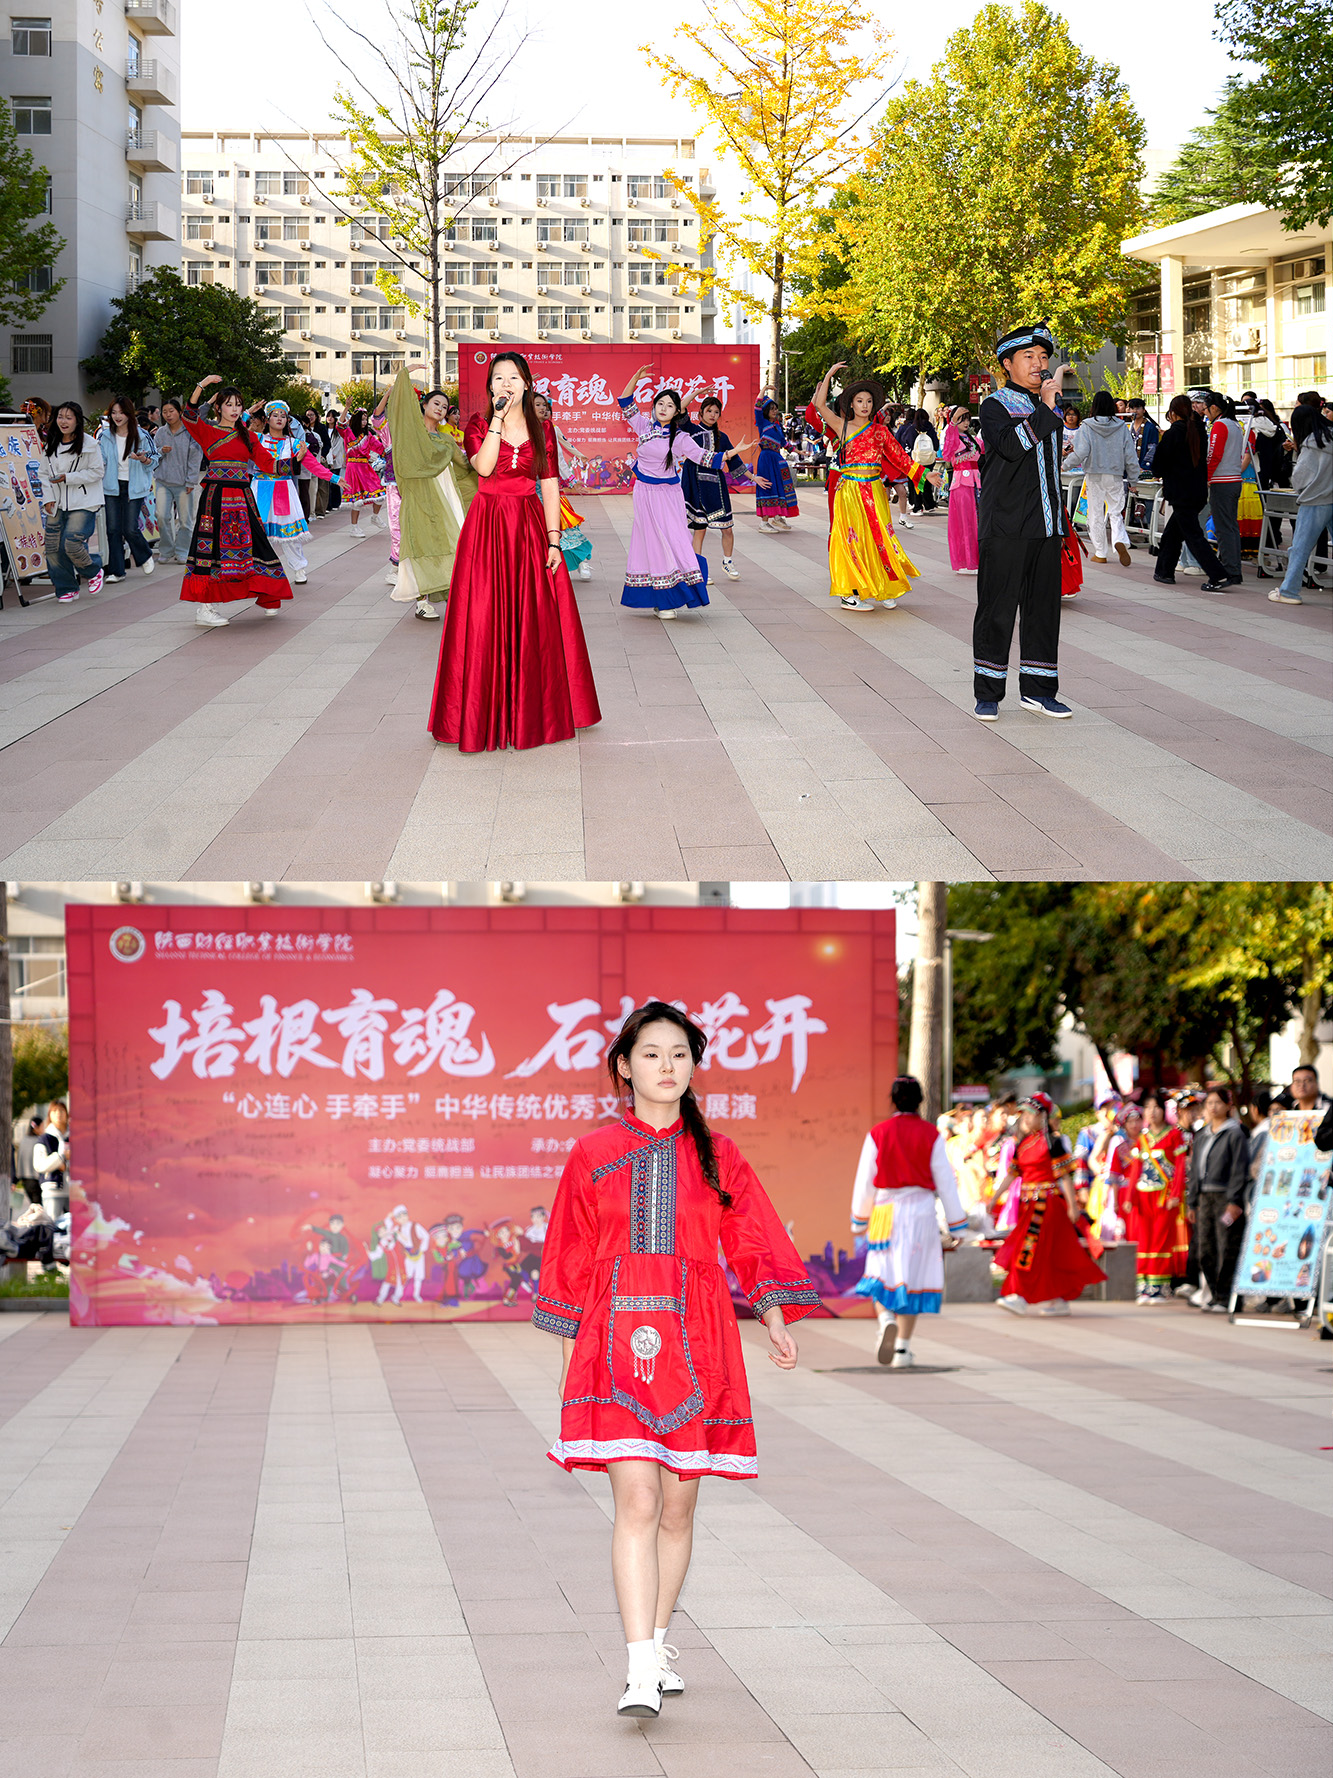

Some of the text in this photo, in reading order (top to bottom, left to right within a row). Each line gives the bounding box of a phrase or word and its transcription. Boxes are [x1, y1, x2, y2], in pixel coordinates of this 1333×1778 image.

[149, 989, 495, 1081] 培根育魂
[436, 1092, 757, 1120] 中华传统优秀文展演
